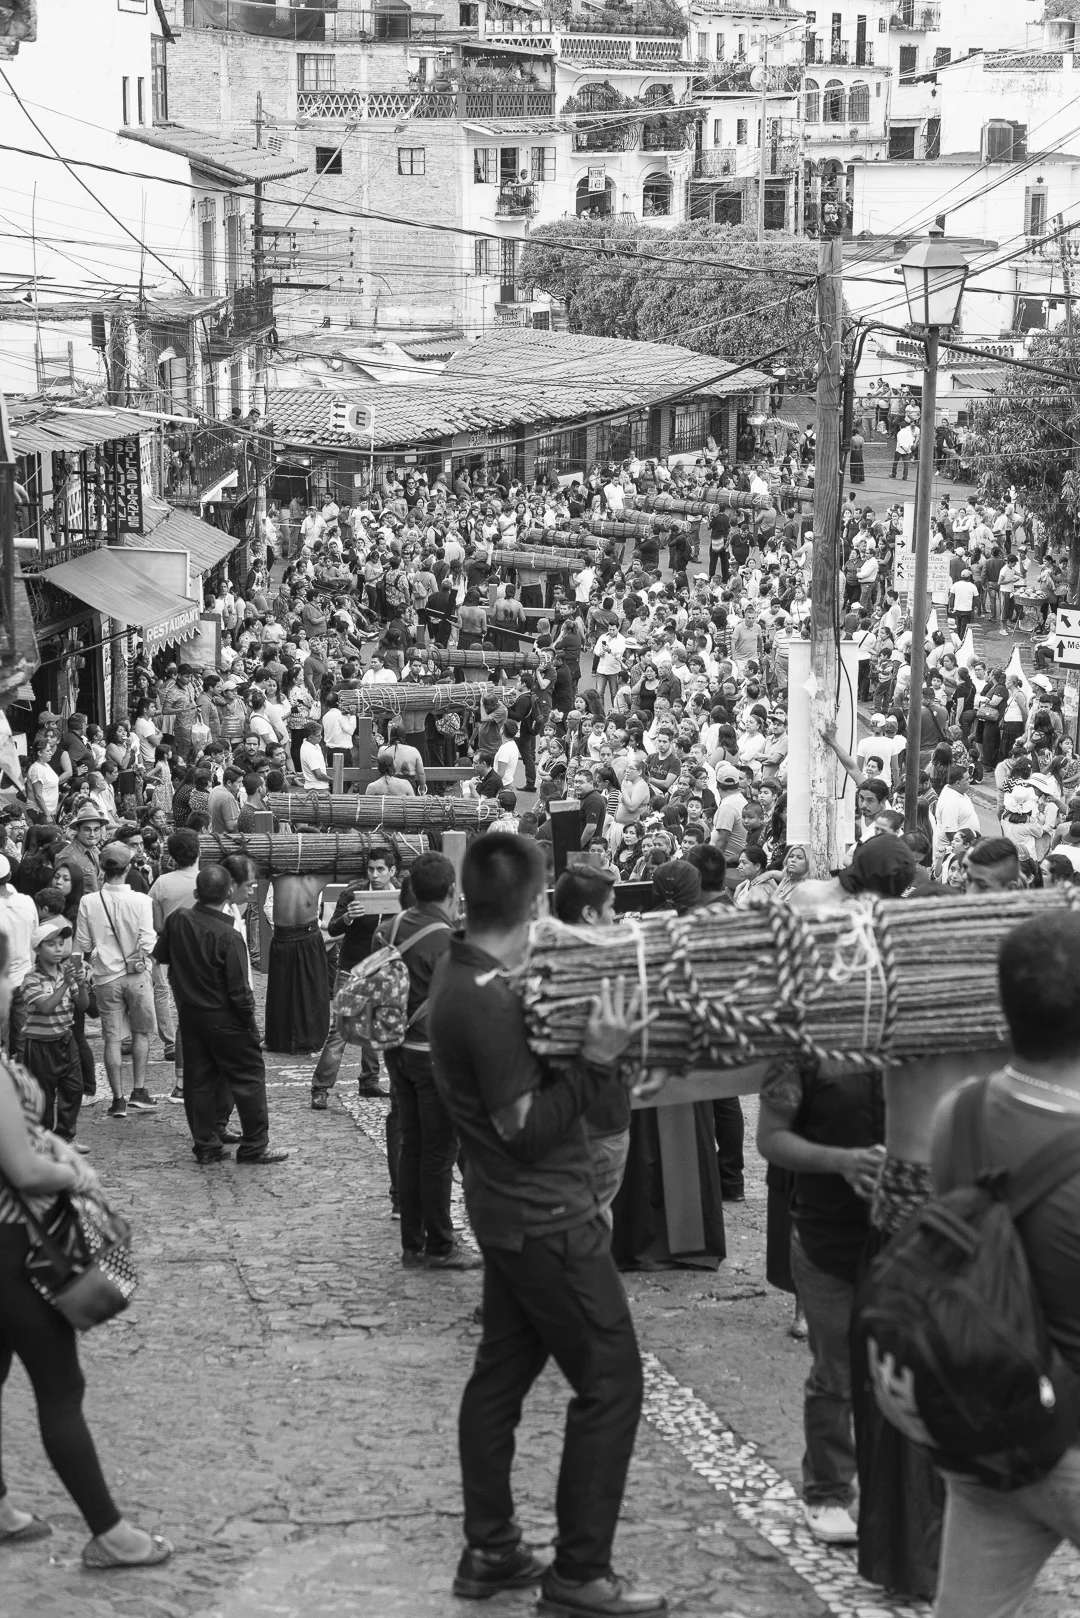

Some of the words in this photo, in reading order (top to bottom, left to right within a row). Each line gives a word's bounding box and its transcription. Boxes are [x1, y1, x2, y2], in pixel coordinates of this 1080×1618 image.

[355, 410, 367, 427] E
[127, 482, 140, 528] GIGANTES
[146, 608, 199, 643] RESTAURANT
